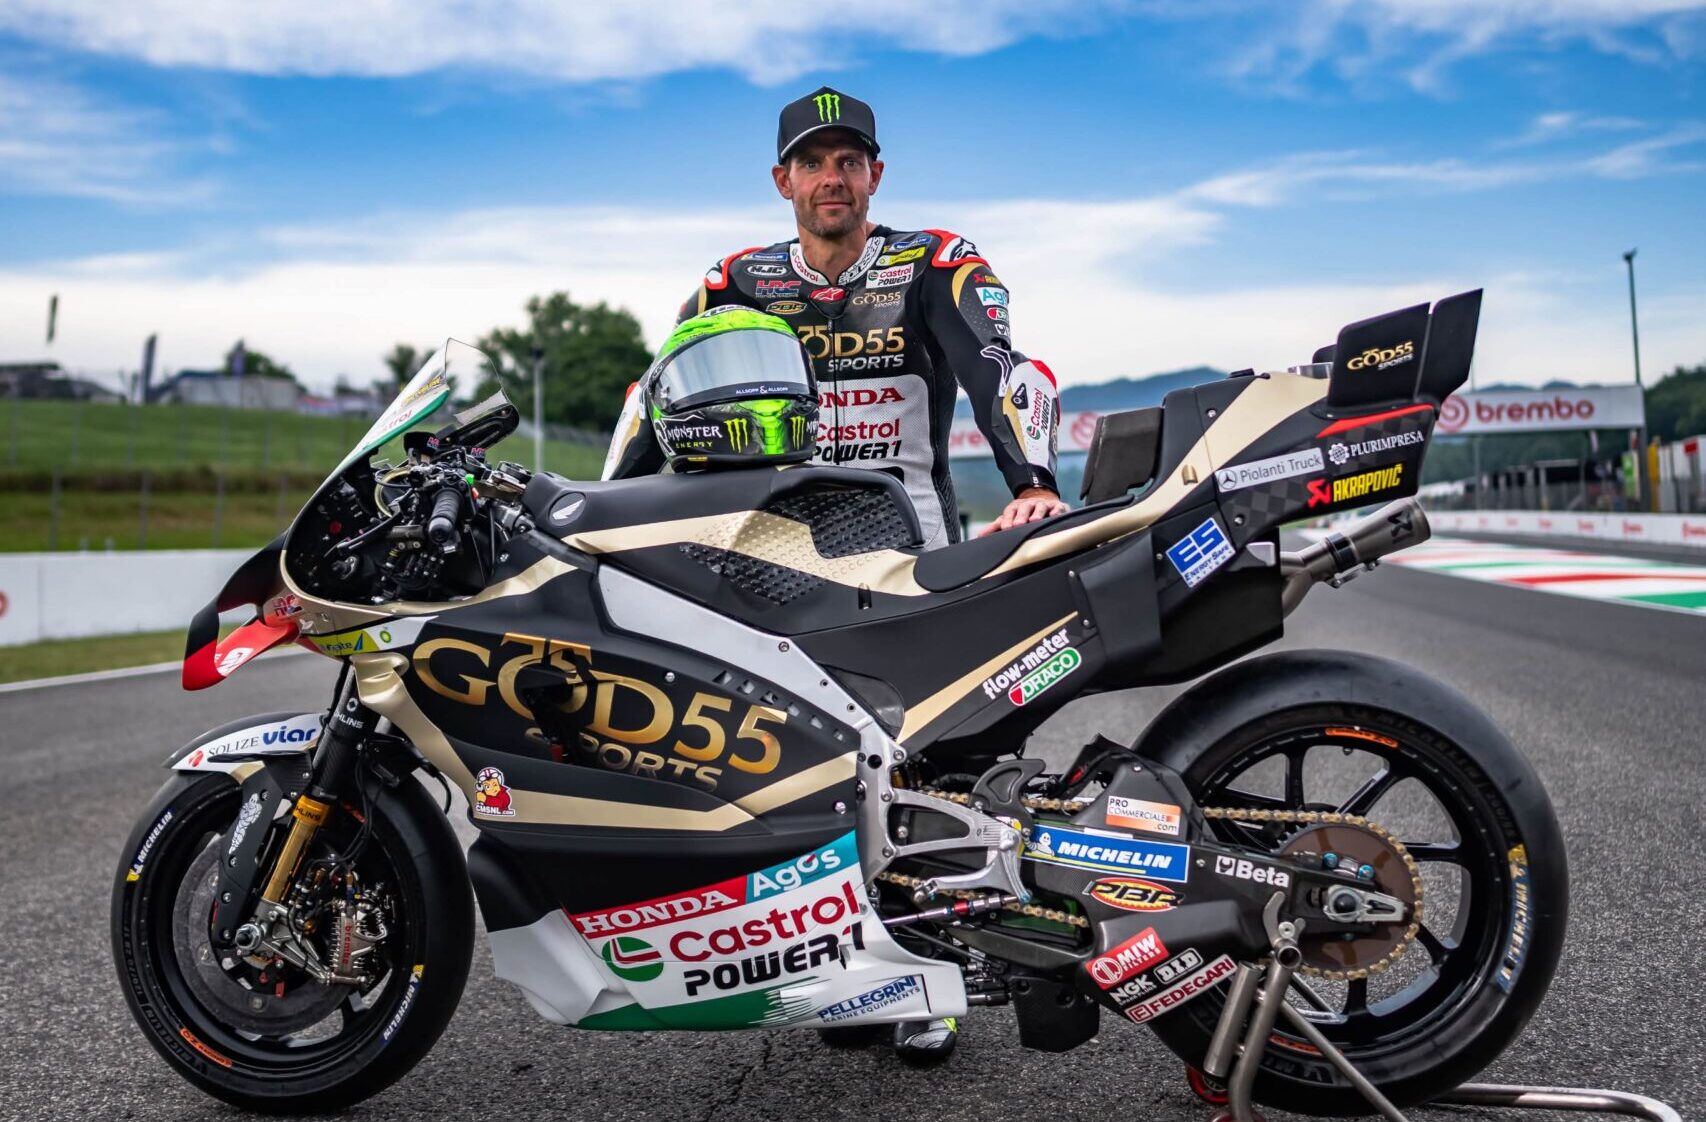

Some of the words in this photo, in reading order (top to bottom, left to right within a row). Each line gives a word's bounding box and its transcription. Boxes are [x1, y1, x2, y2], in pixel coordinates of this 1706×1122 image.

[751, 266, 784, 274] HJC
[794, 255, 819, 282] Castrol
[880, 266, 911, 278] Castrol
[798, 325, 905, 358] OD55
[828, 354, 904, 373] SPORTS
[760, 385, 768, 394] &
[1031, 387, 1043, 427] Castrol
[1475, 396, 1595, 423] brembo
[667, 425, 723, 441] MONSTER
[816, 418, 900, 442] Castrol
[1350, 430, 1424, 457] PLURIMPRESA
[1240, 461, 1286, 483] Piolanti
[1288, 454, 1322, 472] Truck
[1333, 463, 1403, 503] AKRAPOVIČ
[982, 628, 1070, 700] flow-meter
[1022, 653, 1075, 698] DRACO
[208, 736, 260, 756] SOLIZE
[262, 726, 317, 745] viar
[1108, 807, 1167, 822] COMMERCIALE
[1109, 798, 1129, 808] PRO
[137, 811, 173, 863] MICHELIN
[1154, 823, 1178, 832] .com
[1057, 841, 1173, 869] MICHELIN
[1235, 858, 1290, 888] Beta
[576, 890, 738, 934] HONDA
[670, 881, 859, 962] Castrol
[1117, 934, 1157, 966] MIW
[1123, 947, 1162, 972] FILTERS
[817, 975, 917, 1019] PELLEGRINI
[1109, 974, 1156, 1002] NGK
[1148, 959, 1234, 1012] FEDEGARI
[383, 984, 415, 1041] MICHELIN
[822, 1011, 858, 1023] MARINE
[860, 986, 921, 1014] EQUIPMENTS
